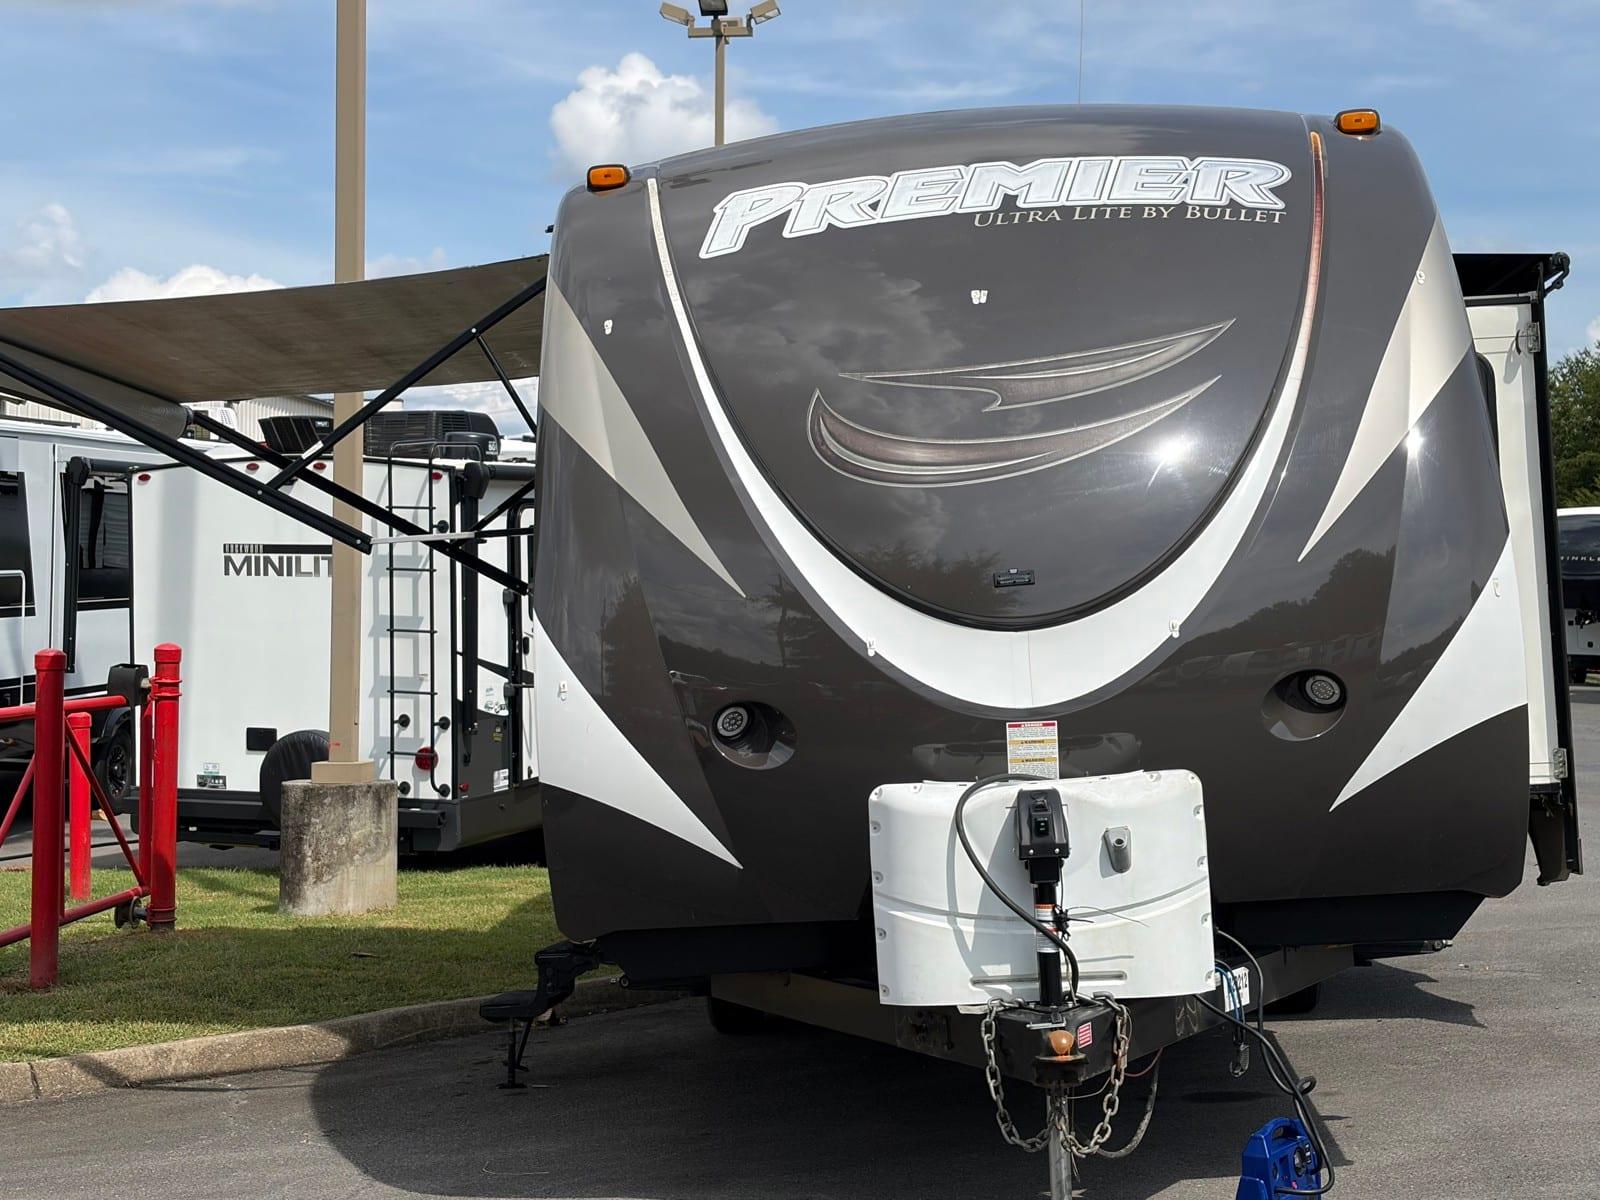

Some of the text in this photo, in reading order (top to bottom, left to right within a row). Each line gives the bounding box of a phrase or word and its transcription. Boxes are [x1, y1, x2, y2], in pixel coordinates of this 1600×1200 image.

[699, 156, 1292, 258] PREMIER
[973, 205, 1287, 227] ULTRA LITE BY BULLET
